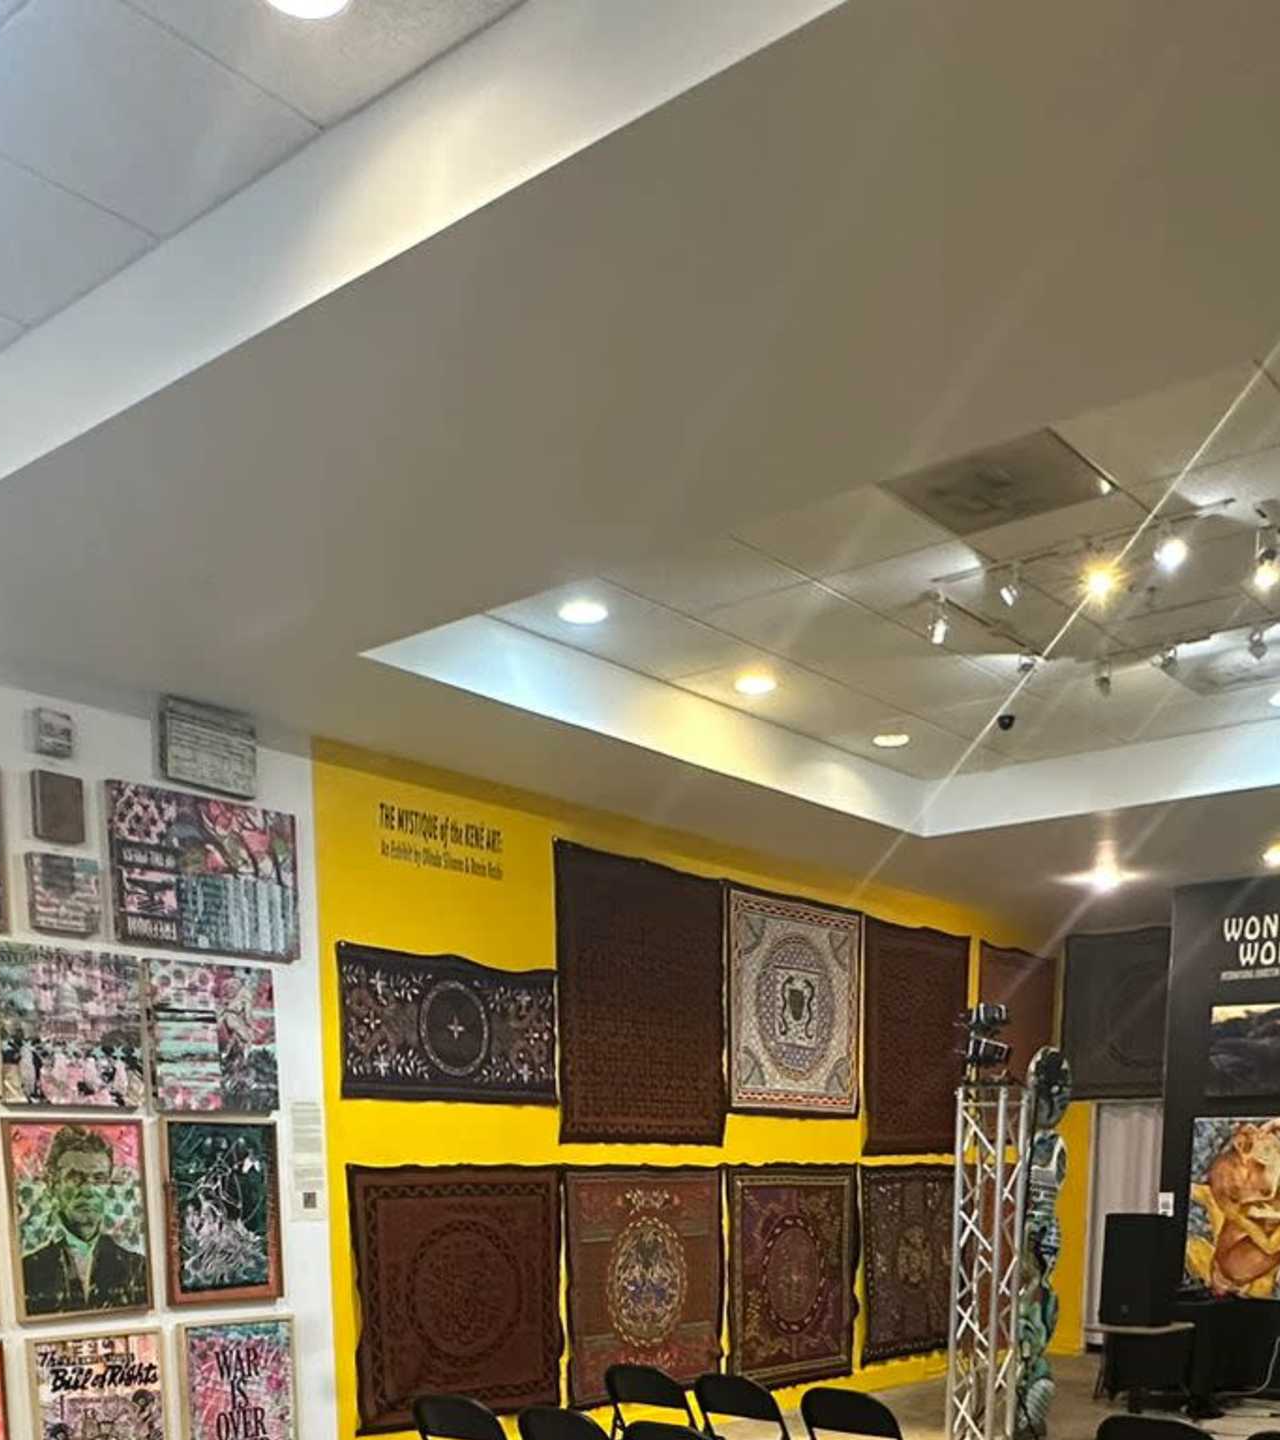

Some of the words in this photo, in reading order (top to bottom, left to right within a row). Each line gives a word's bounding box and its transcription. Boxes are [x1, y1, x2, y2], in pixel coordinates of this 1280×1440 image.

[380, 803, 395, 830] THE
[398, 807, 438, 843] MYSTIQUE
[440, 816, 449, 849] of
[451, 821, 463, 845] the
[50, 1367, 91, 1393] Bill
[107, 1361, 159, 1389] Rights
[213, 1347, 261, 1379] WAR
[230, 1376, 249, 1410] IS
